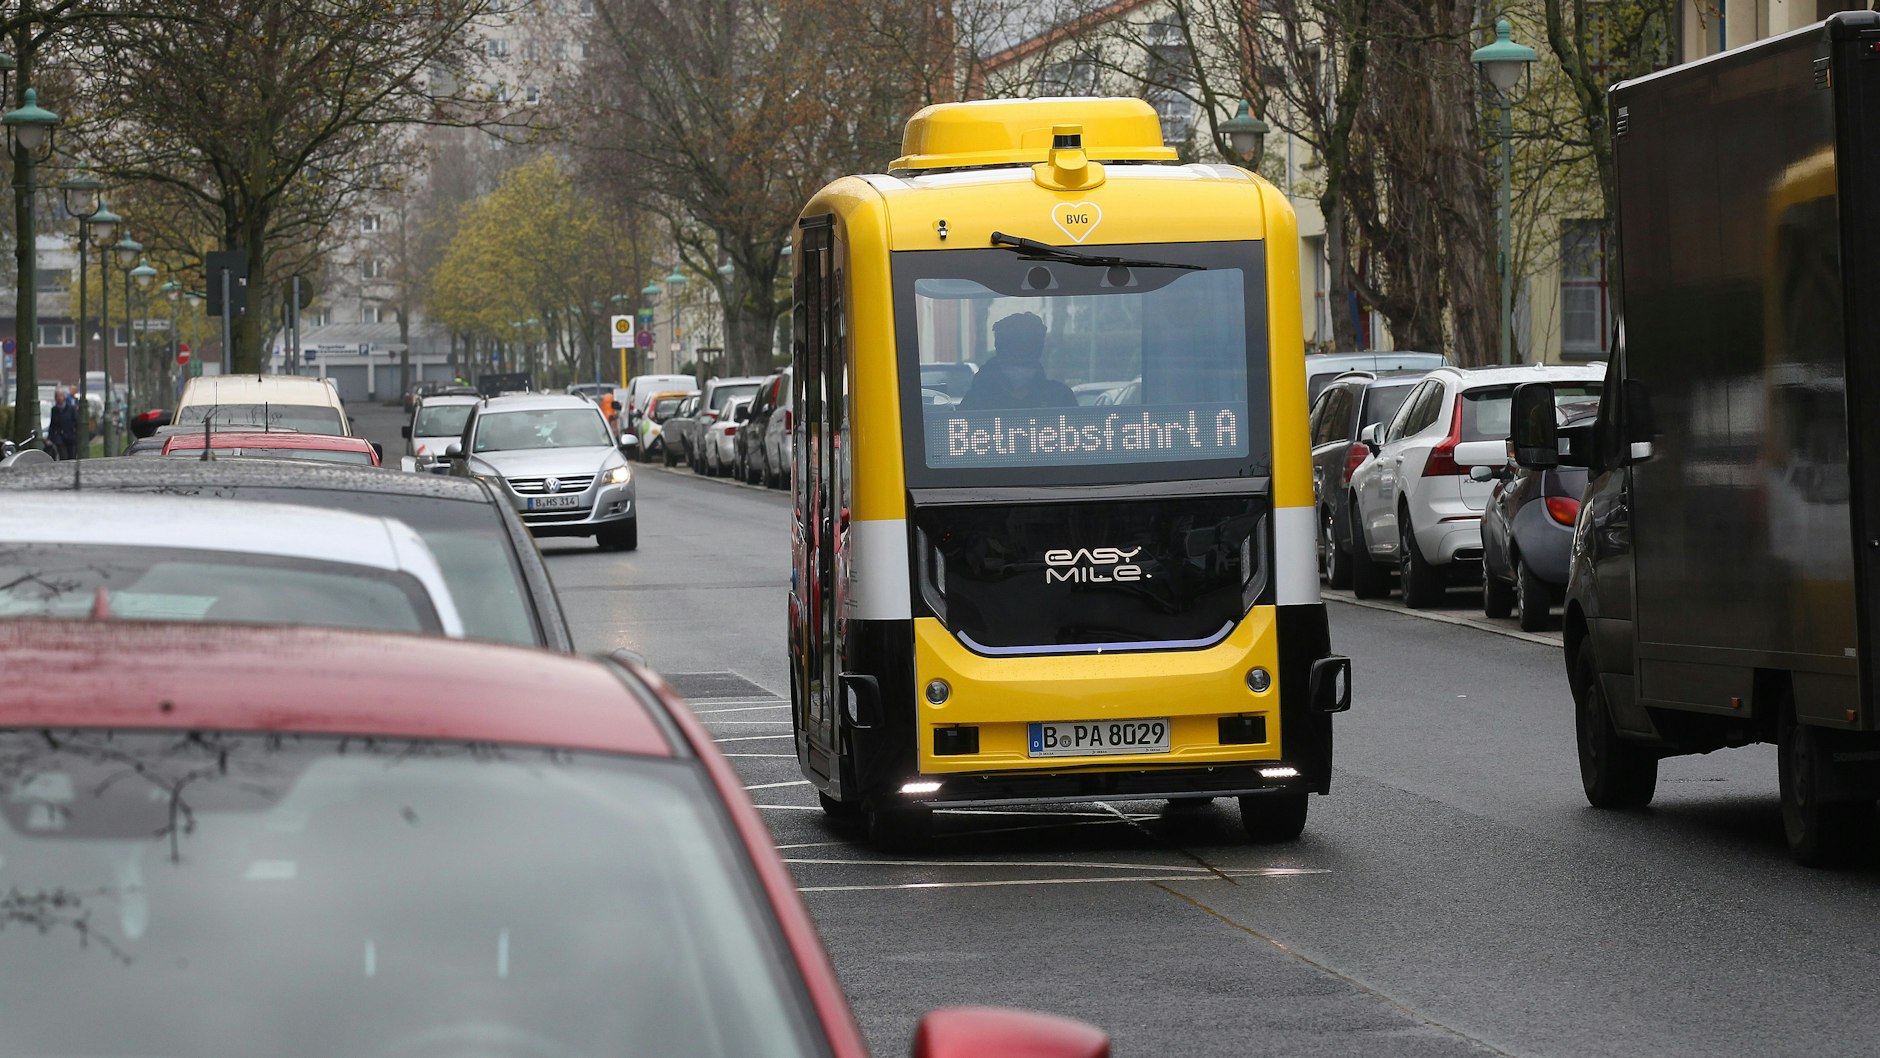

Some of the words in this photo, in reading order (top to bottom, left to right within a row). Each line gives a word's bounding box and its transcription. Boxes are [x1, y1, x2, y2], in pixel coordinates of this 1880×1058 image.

[1066, 213, 1088, 224] BVG
[948, 409, 1202, 456] Betriebsfahrt
[1216, 408, 1237, 447] A
[535, 499, 542, 507] B
[546, 498, 557, 507] HS
[560, 497, 575, 506] 314
[1033, 740, 1039, 748] D
[1043, 726, 1058, 748] B
[1074, 725, 1103, 747] PA
[1108, 722, 1165, 746] 8029
